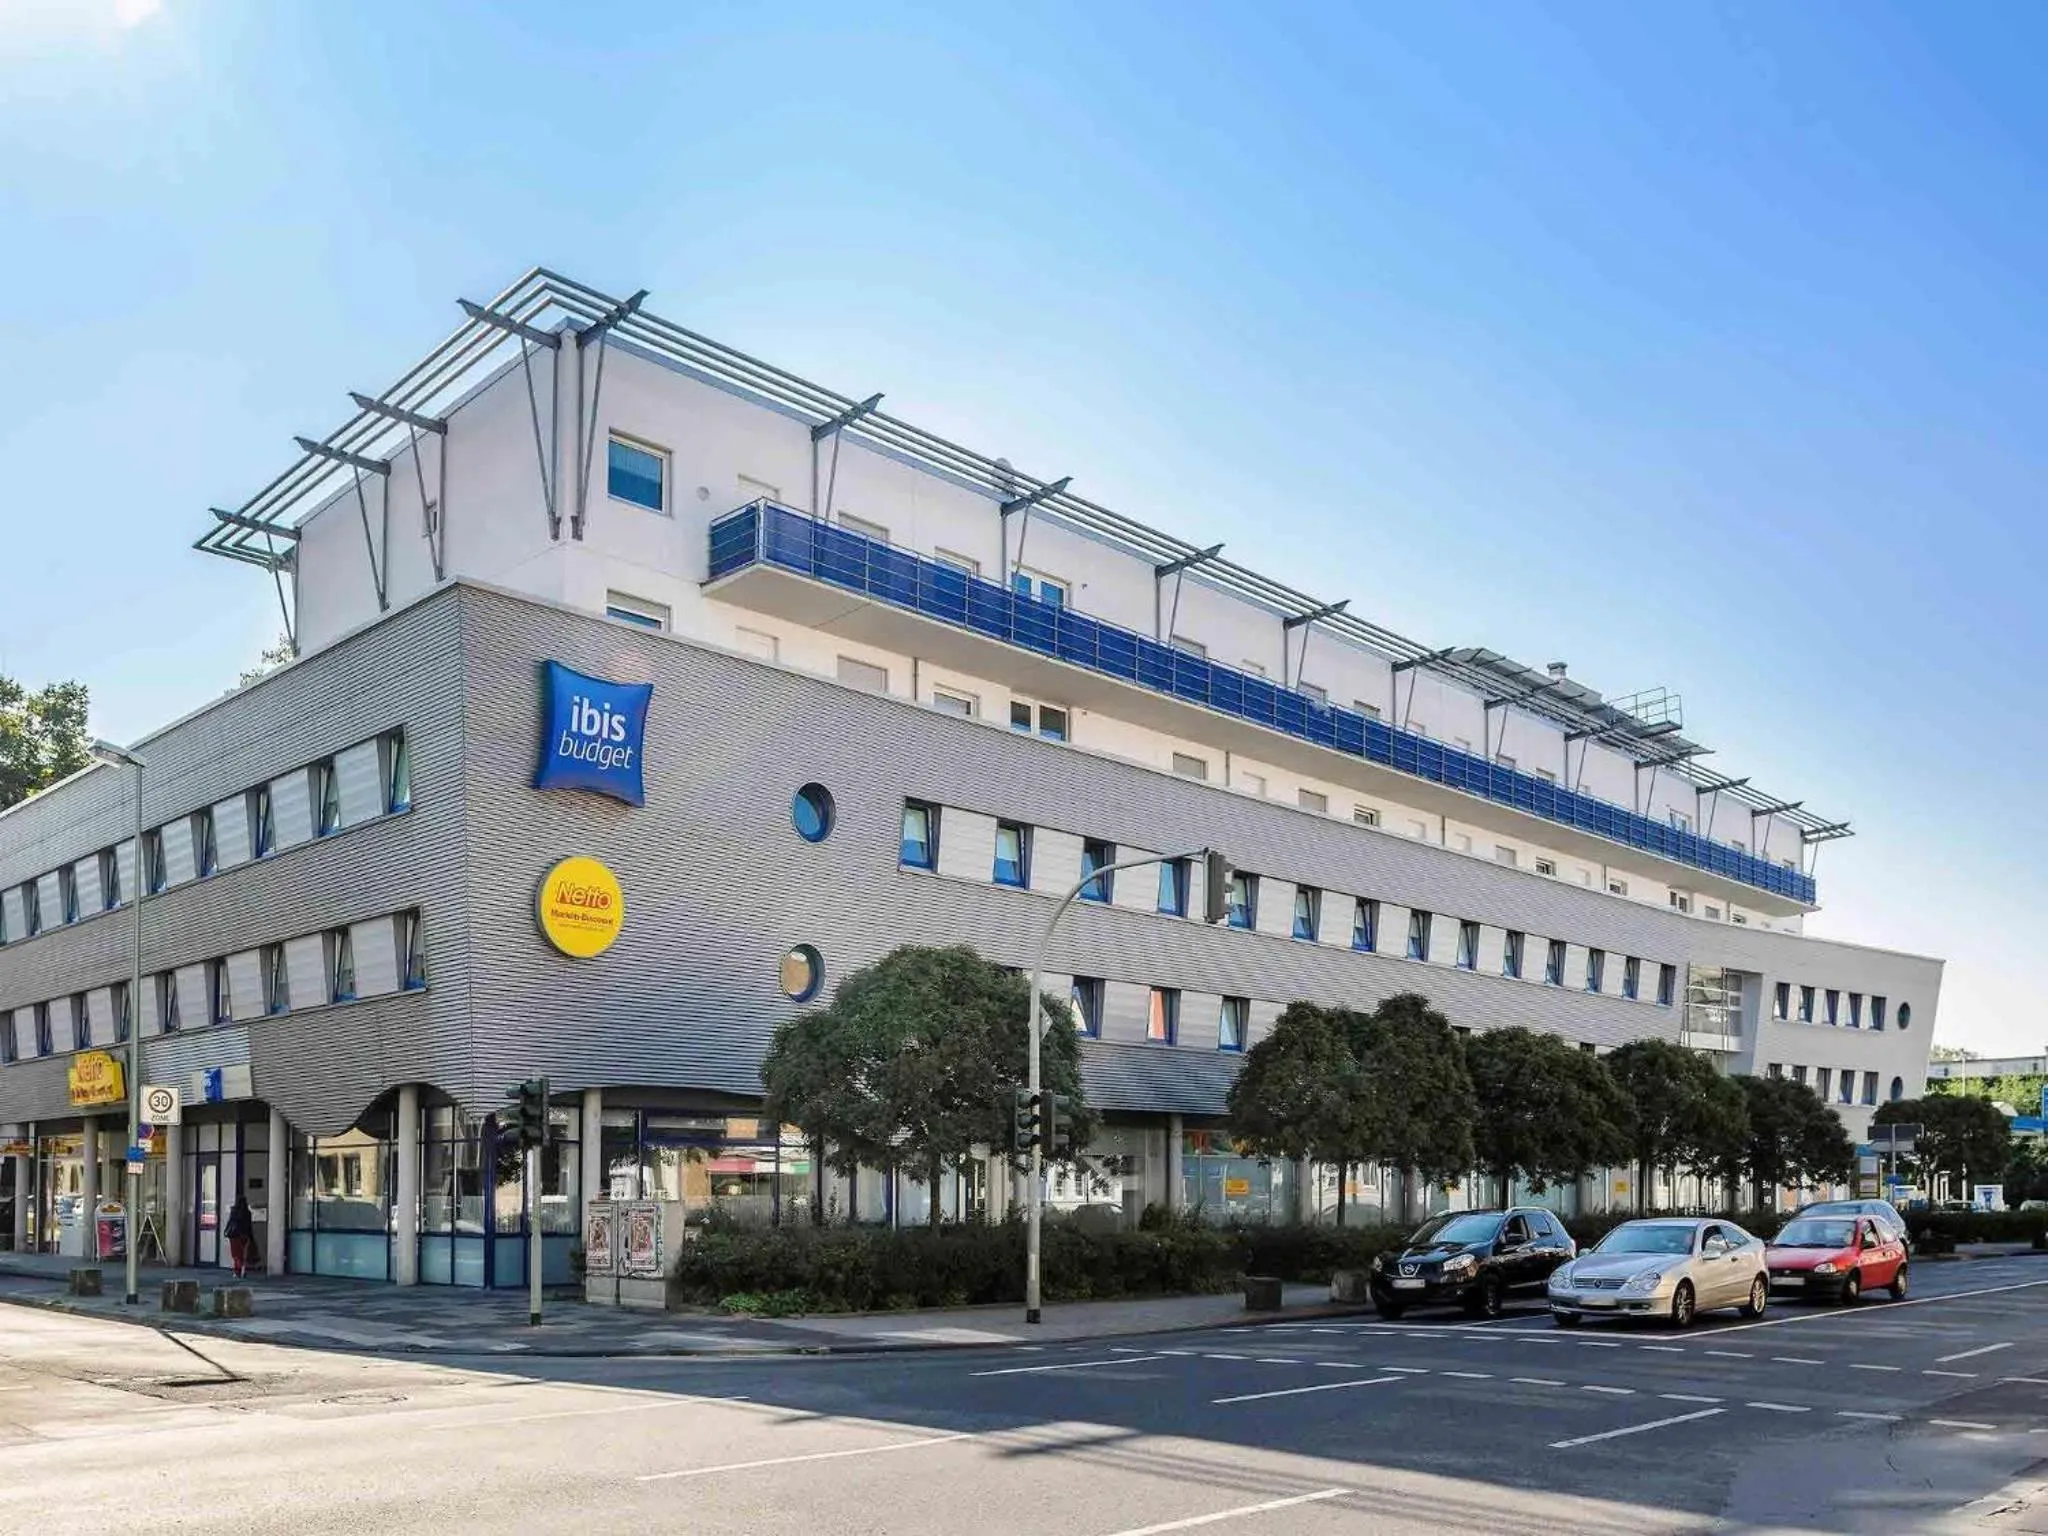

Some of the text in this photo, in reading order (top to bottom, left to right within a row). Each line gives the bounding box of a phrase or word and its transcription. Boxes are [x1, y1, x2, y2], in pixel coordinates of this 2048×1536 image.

[571, 695, 626, 742] ibis
[559, 729, 634, 770] budget
[556, 880, 613, 910] Netto
[153, 1095, 169, 1108] 30
